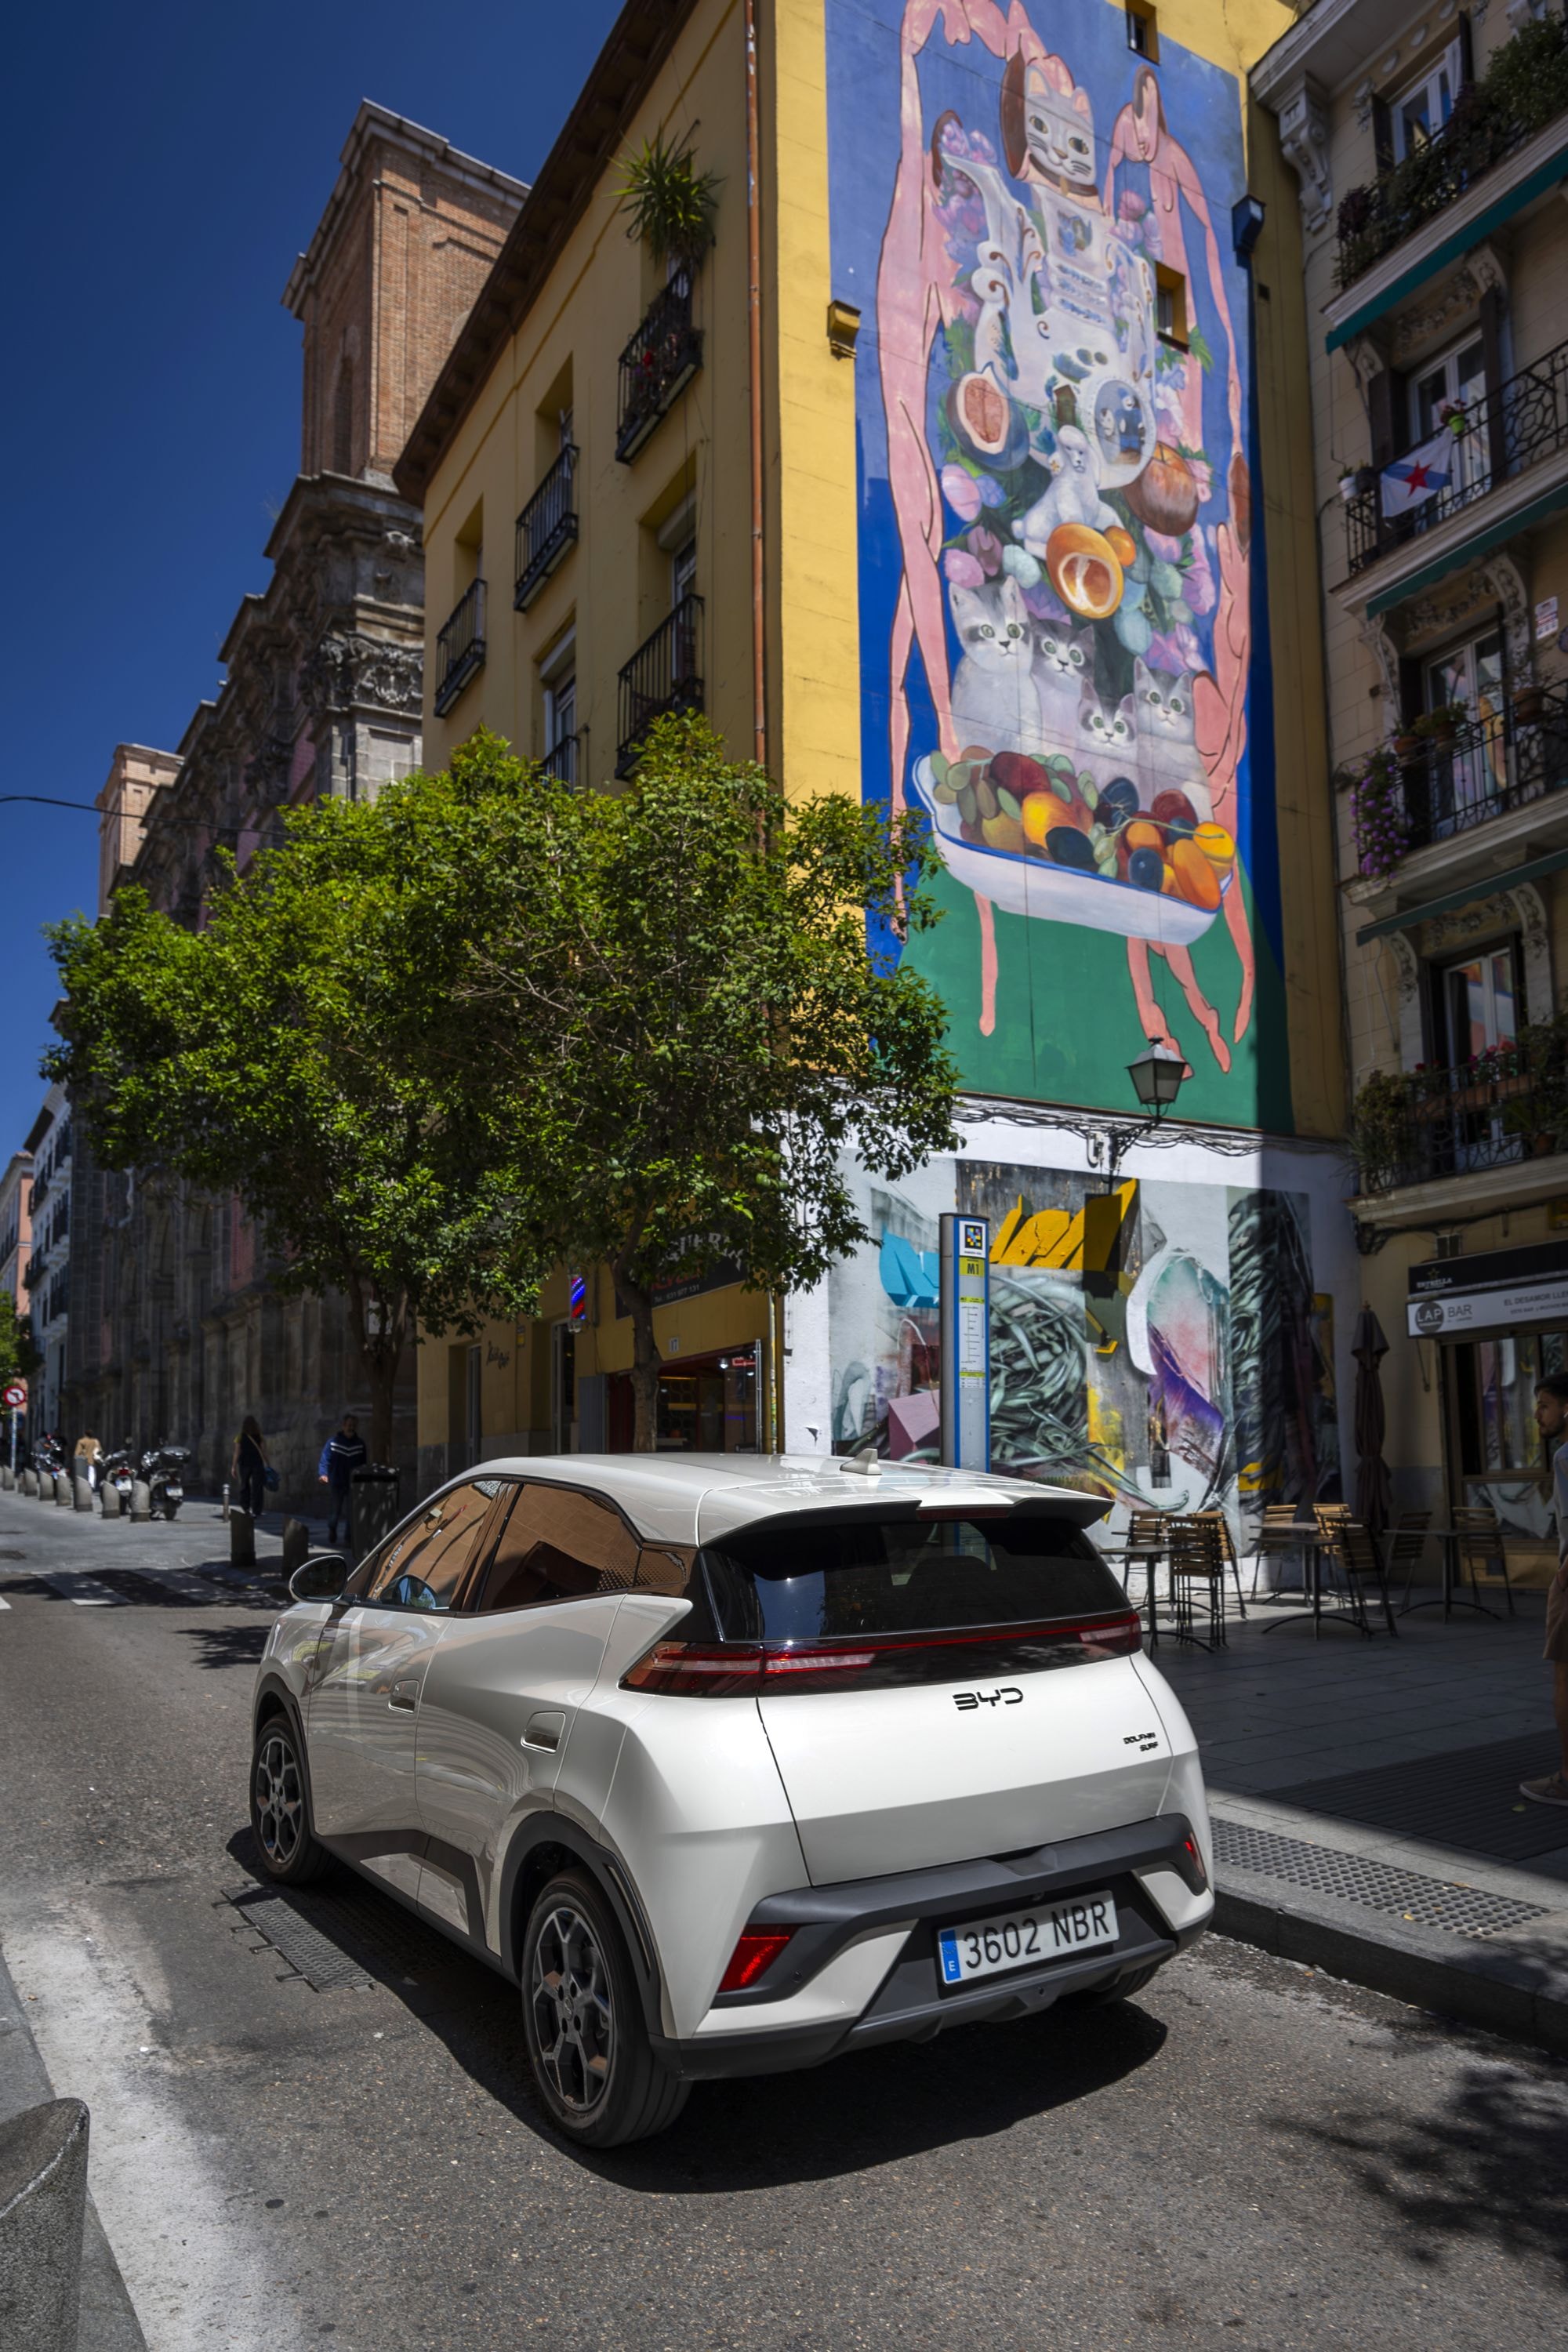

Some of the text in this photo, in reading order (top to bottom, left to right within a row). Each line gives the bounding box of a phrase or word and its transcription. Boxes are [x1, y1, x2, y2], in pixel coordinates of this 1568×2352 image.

[967, 1263, 979, 1275] M1
[1417, 1305, 1472, 1322] LAP BAR
[953, 1686, 1024, 1711] BYD
[964, 1900, 1110, 1969] 3602 NBR
[948, 1960, 956, 1973] E
